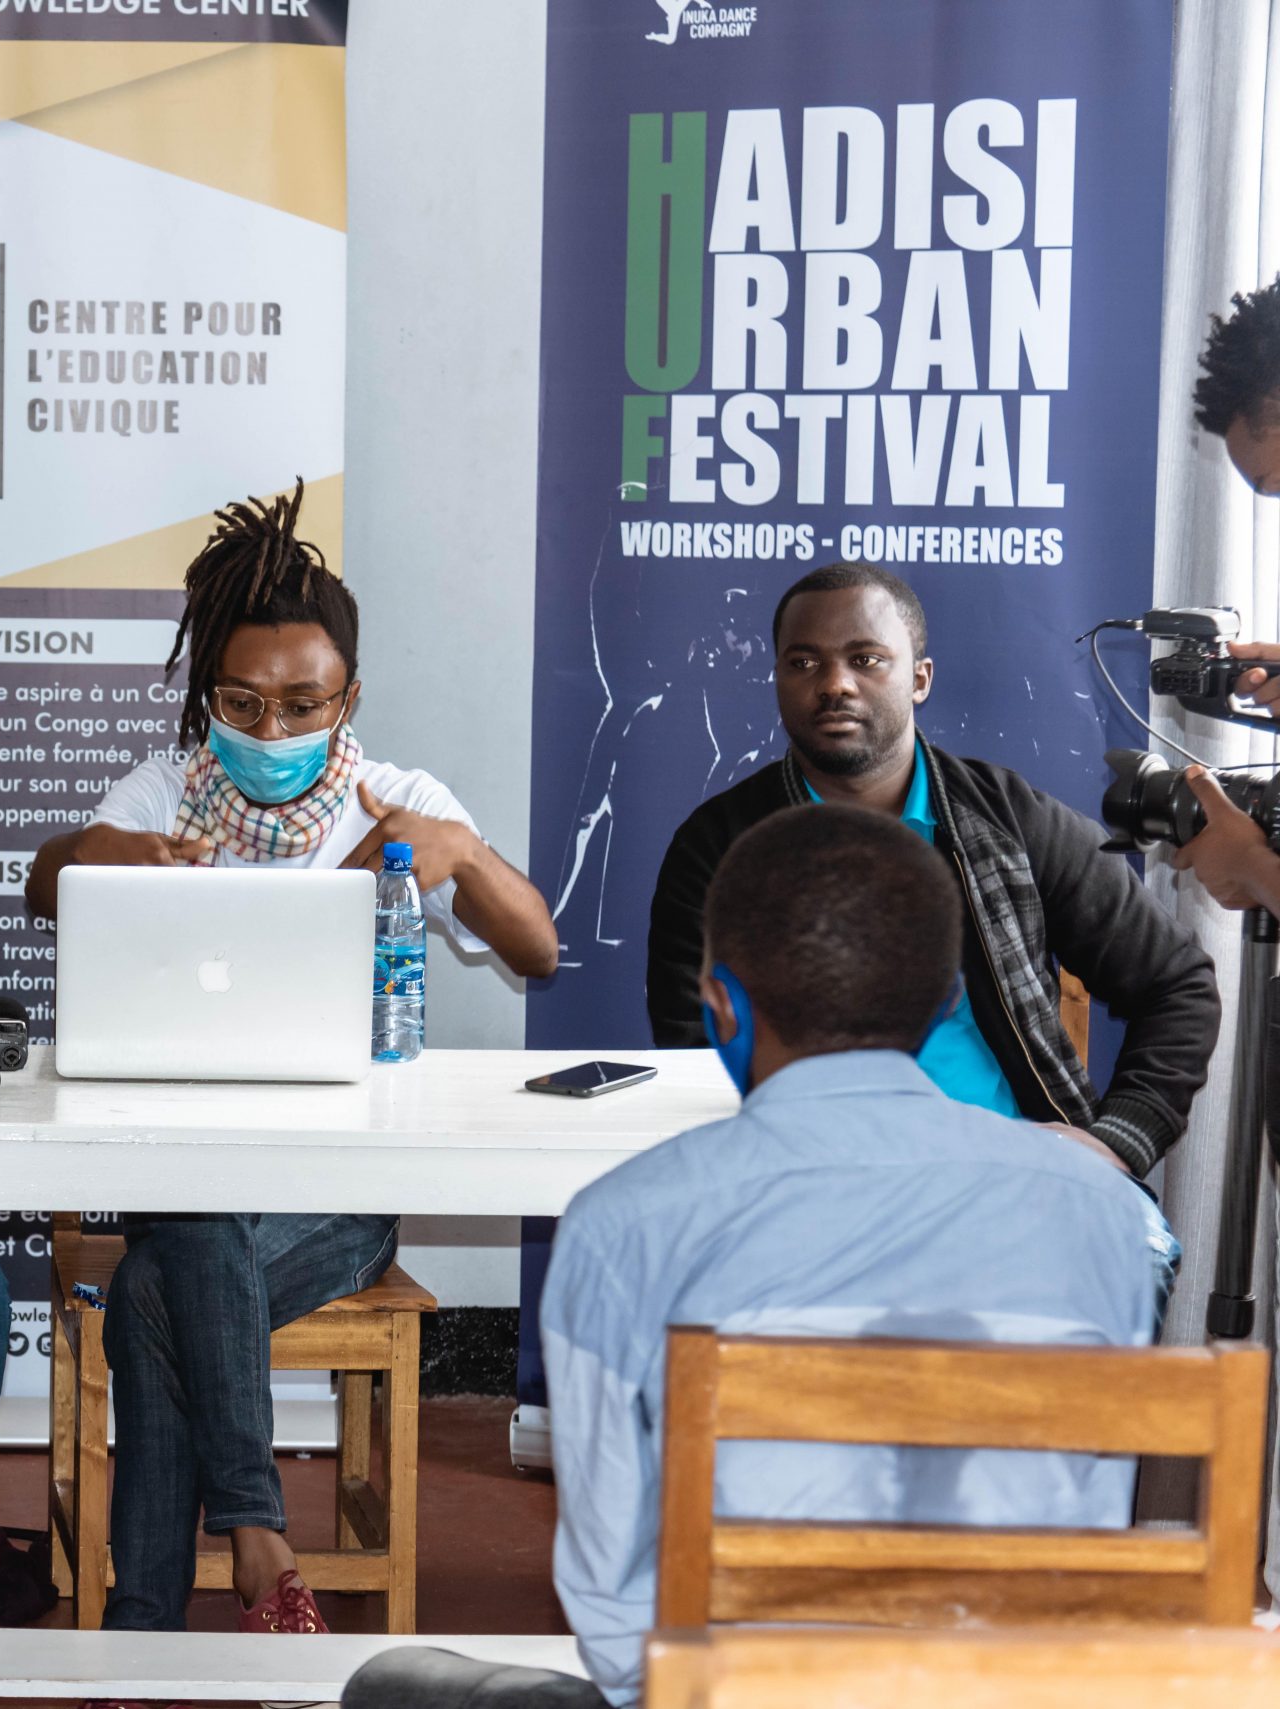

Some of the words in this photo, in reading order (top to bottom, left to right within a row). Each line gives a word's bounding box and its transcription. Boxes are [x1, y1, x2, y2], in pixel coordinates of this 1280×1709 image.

[682, 9, 717, 24] INUKA
[719, 7, 758, 22] DANCE
[689, 22, 752, 39] COMPAGNY
[628, 98, 1077, 253] HADISI
[28, 299, 167, 335] CENTRE
[184, 302, 282, 336] POUR
[624, 249, 1073, 393] URBAN
[28, 350, 268, 385] L'EDUCATION
[27, 399, 180, 436] CIVIQUE
[622, 393, 1065, 508] FESTIVAL
[620, 521, 815, 562] WORKSHOPS
[840, 524, 1064, 566] CONFERENCES
[15, 682, 82, 706] aspire
[90, 684, 103, 702] à
[112, 690, 139, 703] un
[0, 717, 27, 731] un
[35, 712, 109, 738] Congo
[116, 719, 167, 733] avec
[53, 742, 139, 766] formée,
[147, 743, 191, 764] info
[29, 778, 67, 793] son
[75, 775, 118, 794] aut
[2, 942, 56, 960] trave
[11, 1307, 51, 1322] owle
